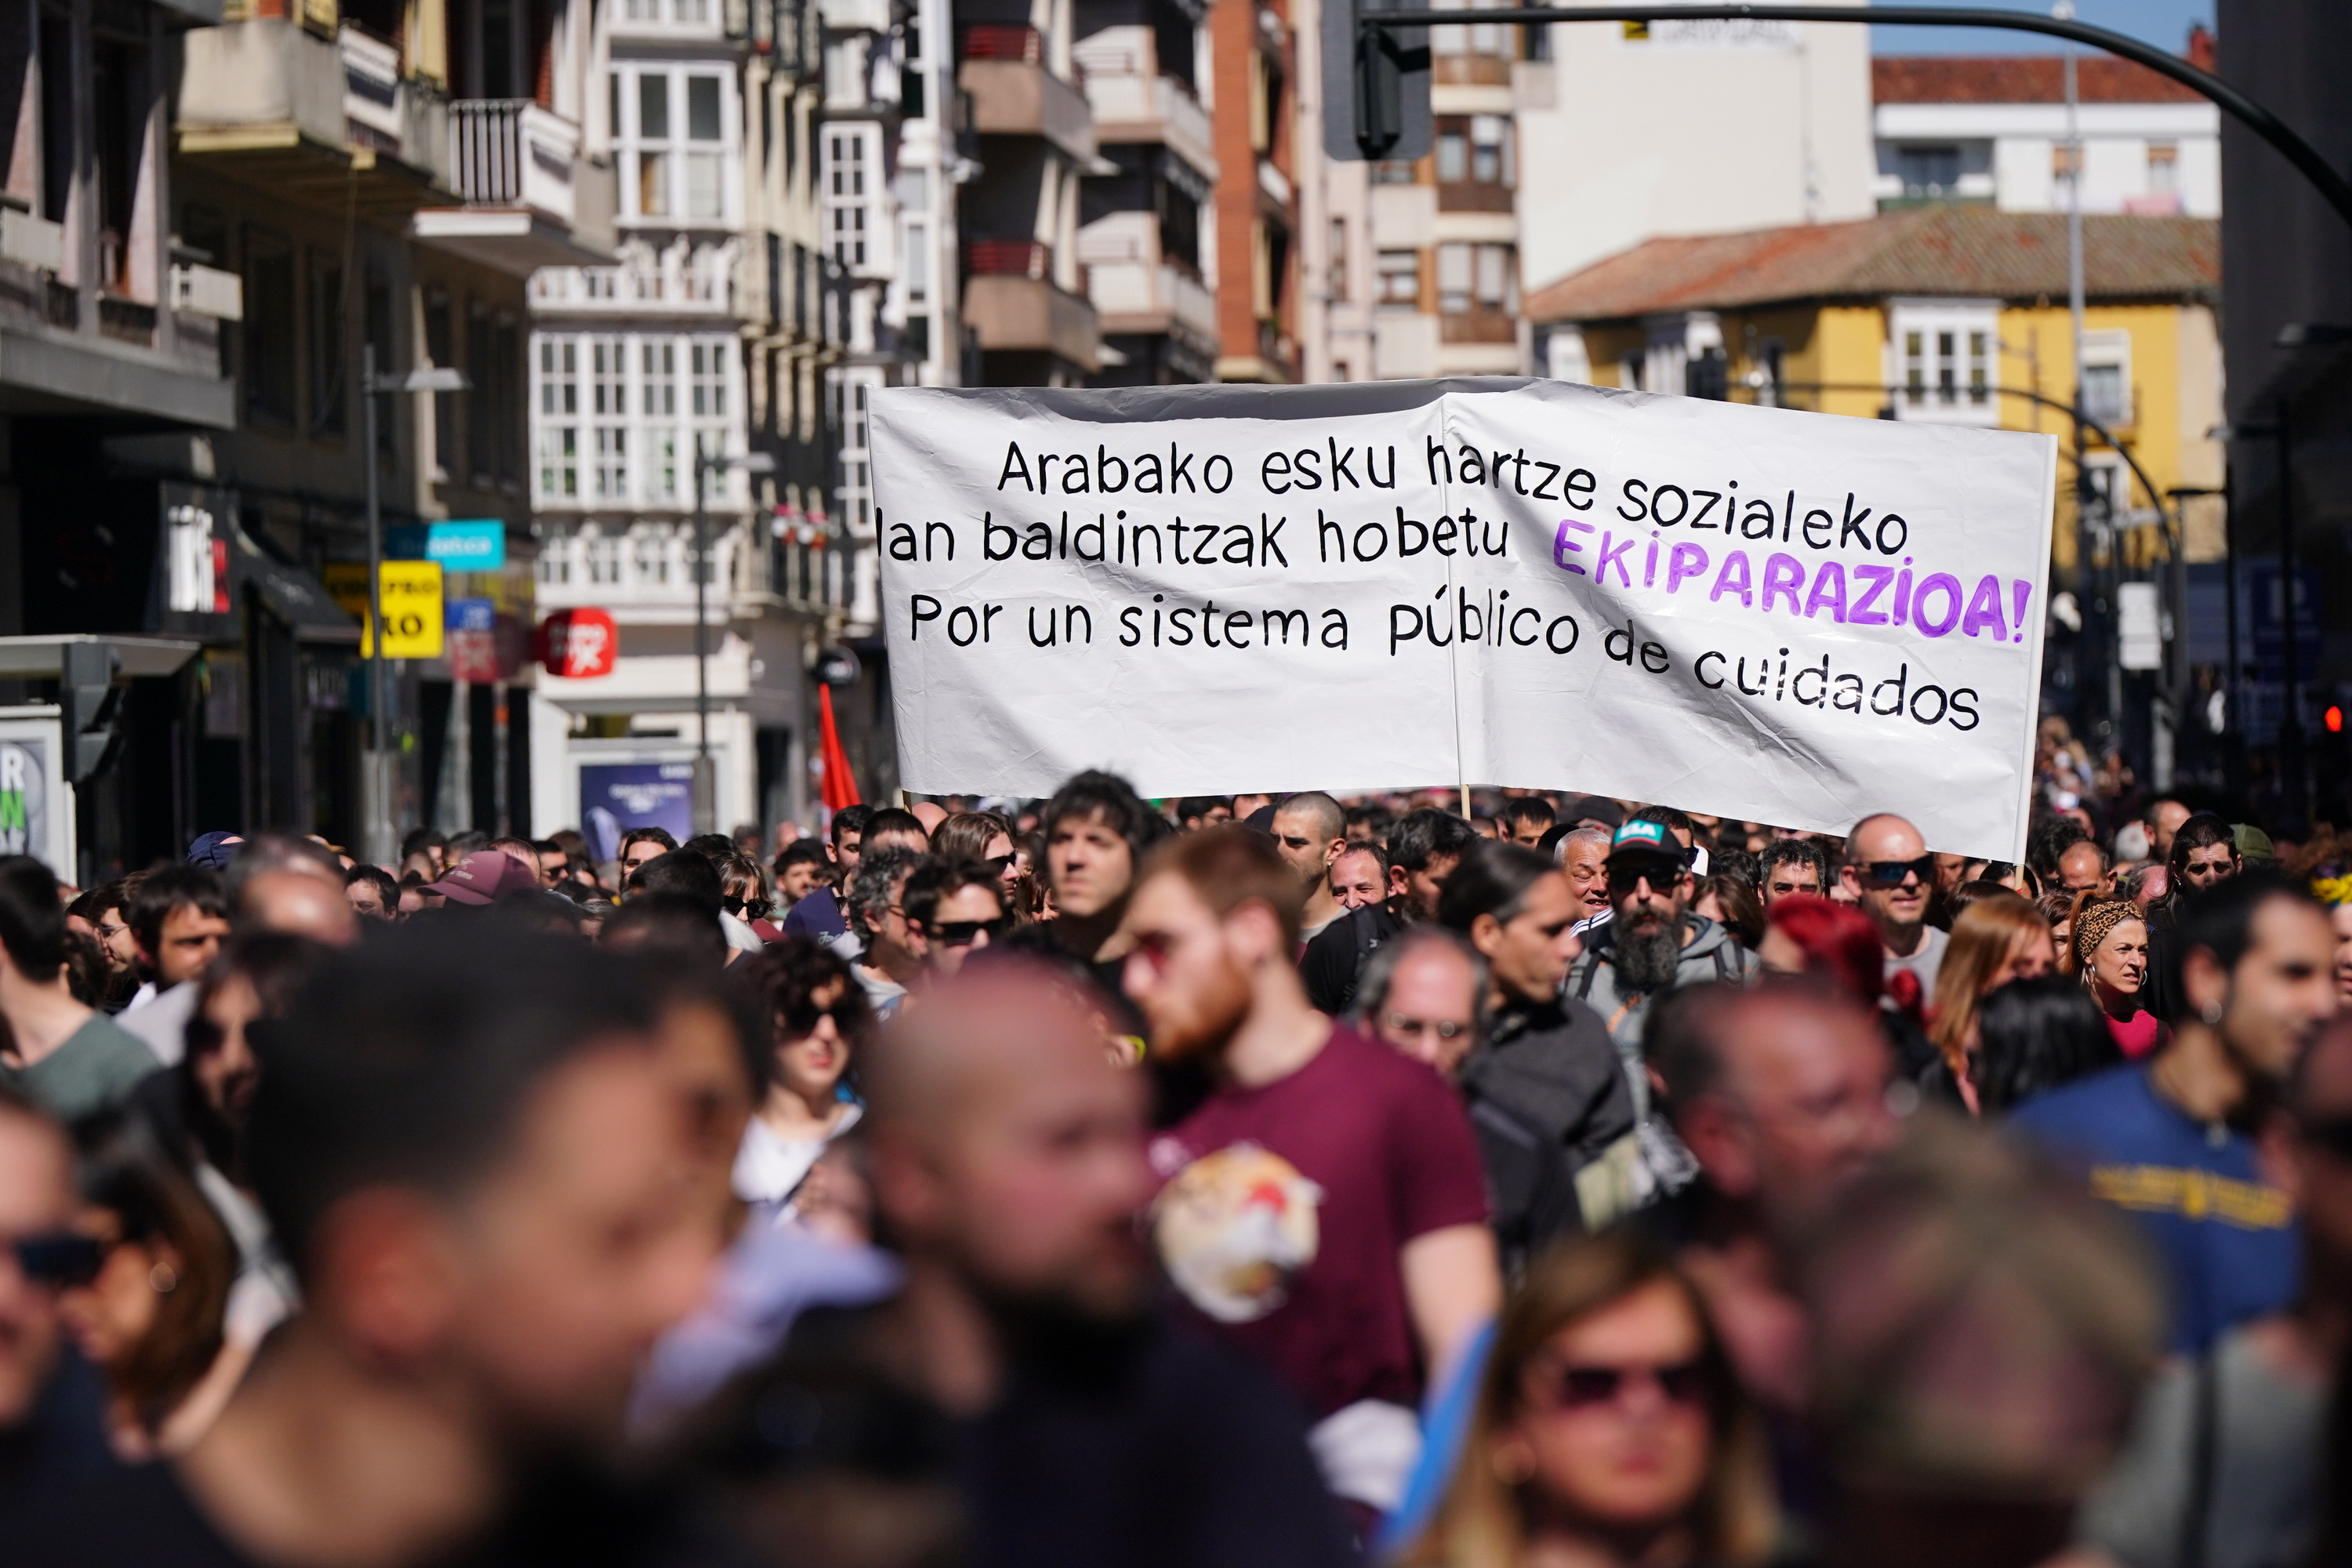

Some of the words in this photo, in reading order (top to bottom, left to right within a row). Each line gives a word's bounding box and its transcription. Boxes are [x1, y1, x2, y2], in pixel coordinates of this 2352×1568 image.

[875, 506, 955, 562] lan
[1317, 506, 1508, 562] hobetu
[996, 441, 1233, 496] Arabako
[1261, 436, 1396, 495] esku
[1427, 434, 1596, 511] hartze
[1617, 478, 1907, 555] sozialeko
[911, 594, 1004, 647] Por
[1029, 604, 1091, 648] un
[1119, 593, 1348, 651] sistema
[1390, 584, 1579, 657] público
[1604, 619, 1671, 674] de
[1693, 648, 1980, 731] cuidados
[1619, 822, 1657, 839] ELA
